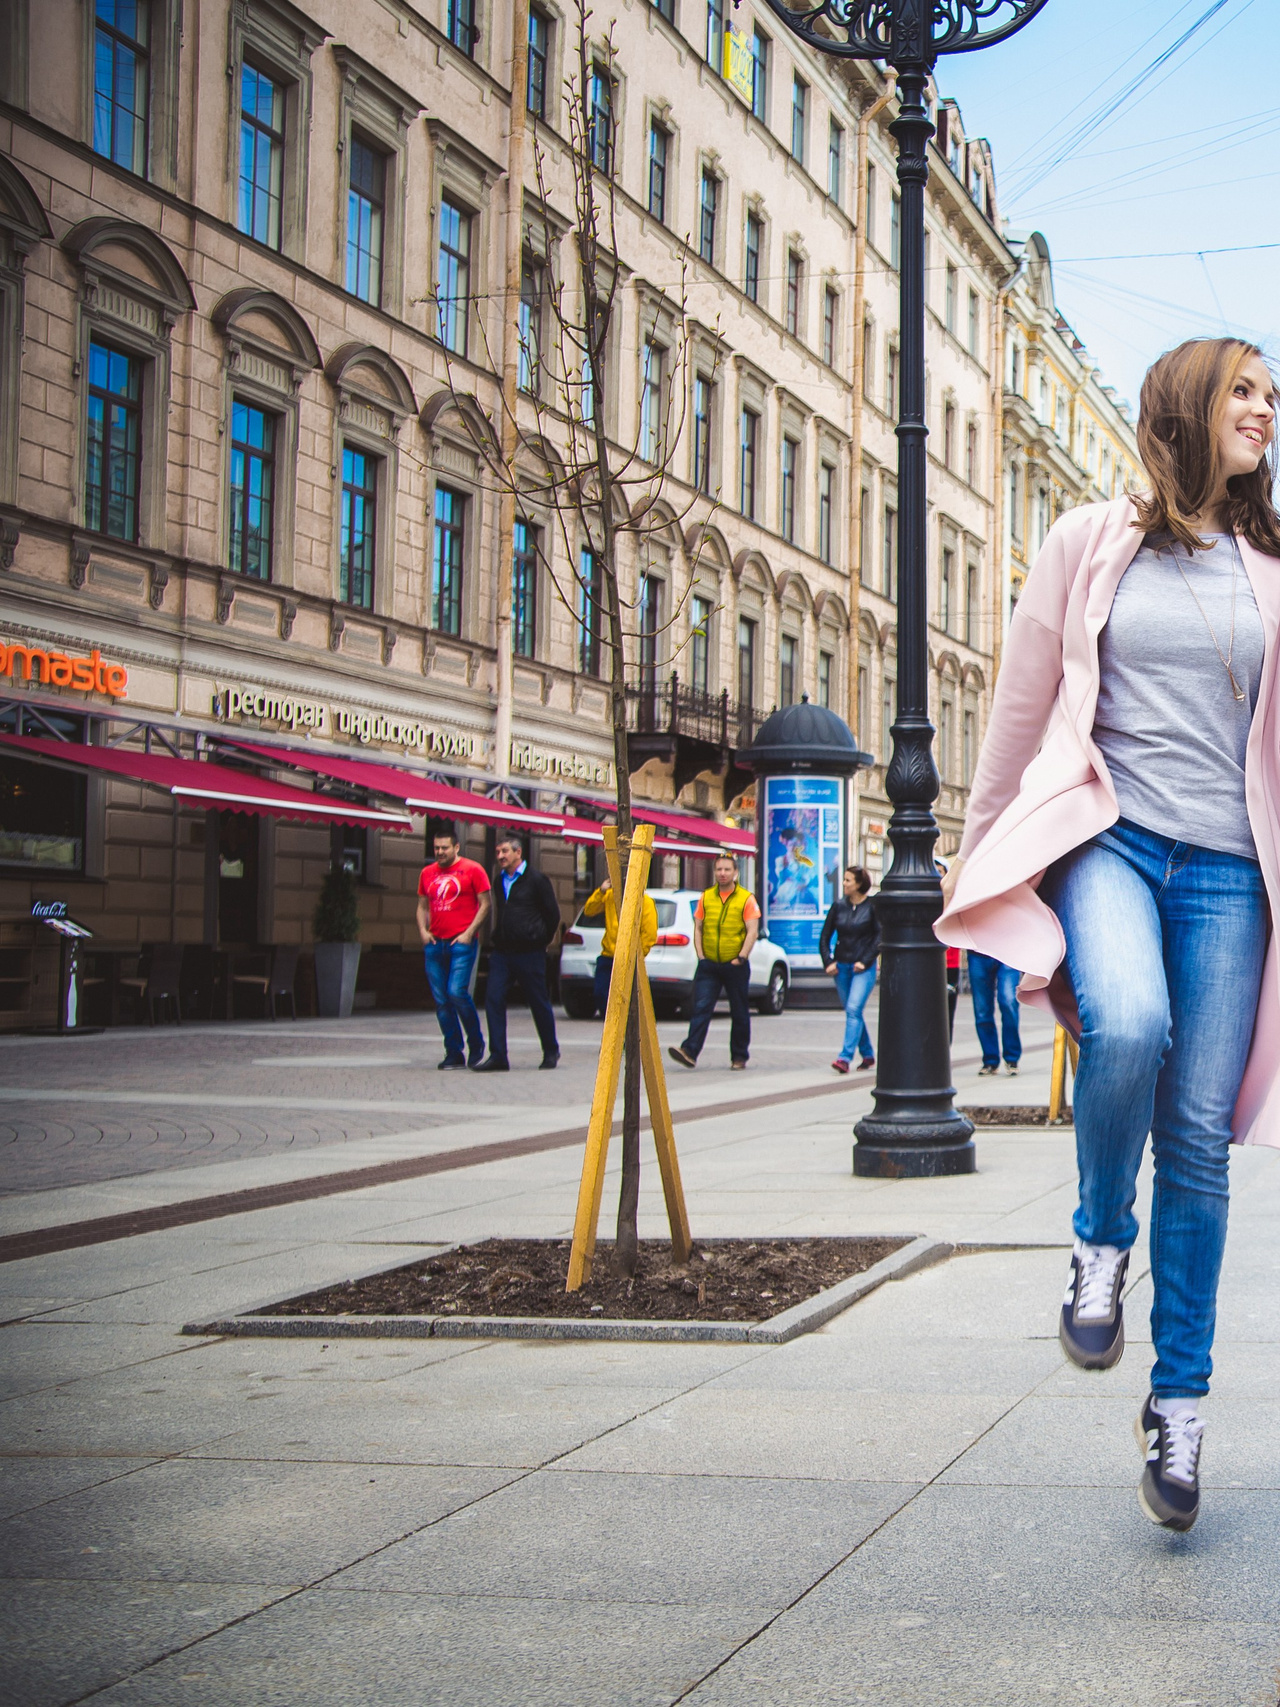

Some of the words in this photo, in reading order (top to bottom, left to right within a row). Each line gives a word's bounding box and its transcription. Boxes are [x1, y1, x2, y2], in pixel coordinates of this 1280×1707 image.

[0, 642, 128, 697] maste
[227, 688, 325, 731] ресторан
[338, 708, 425, 748] индийской
[431, 730, 476, 759] кухни
